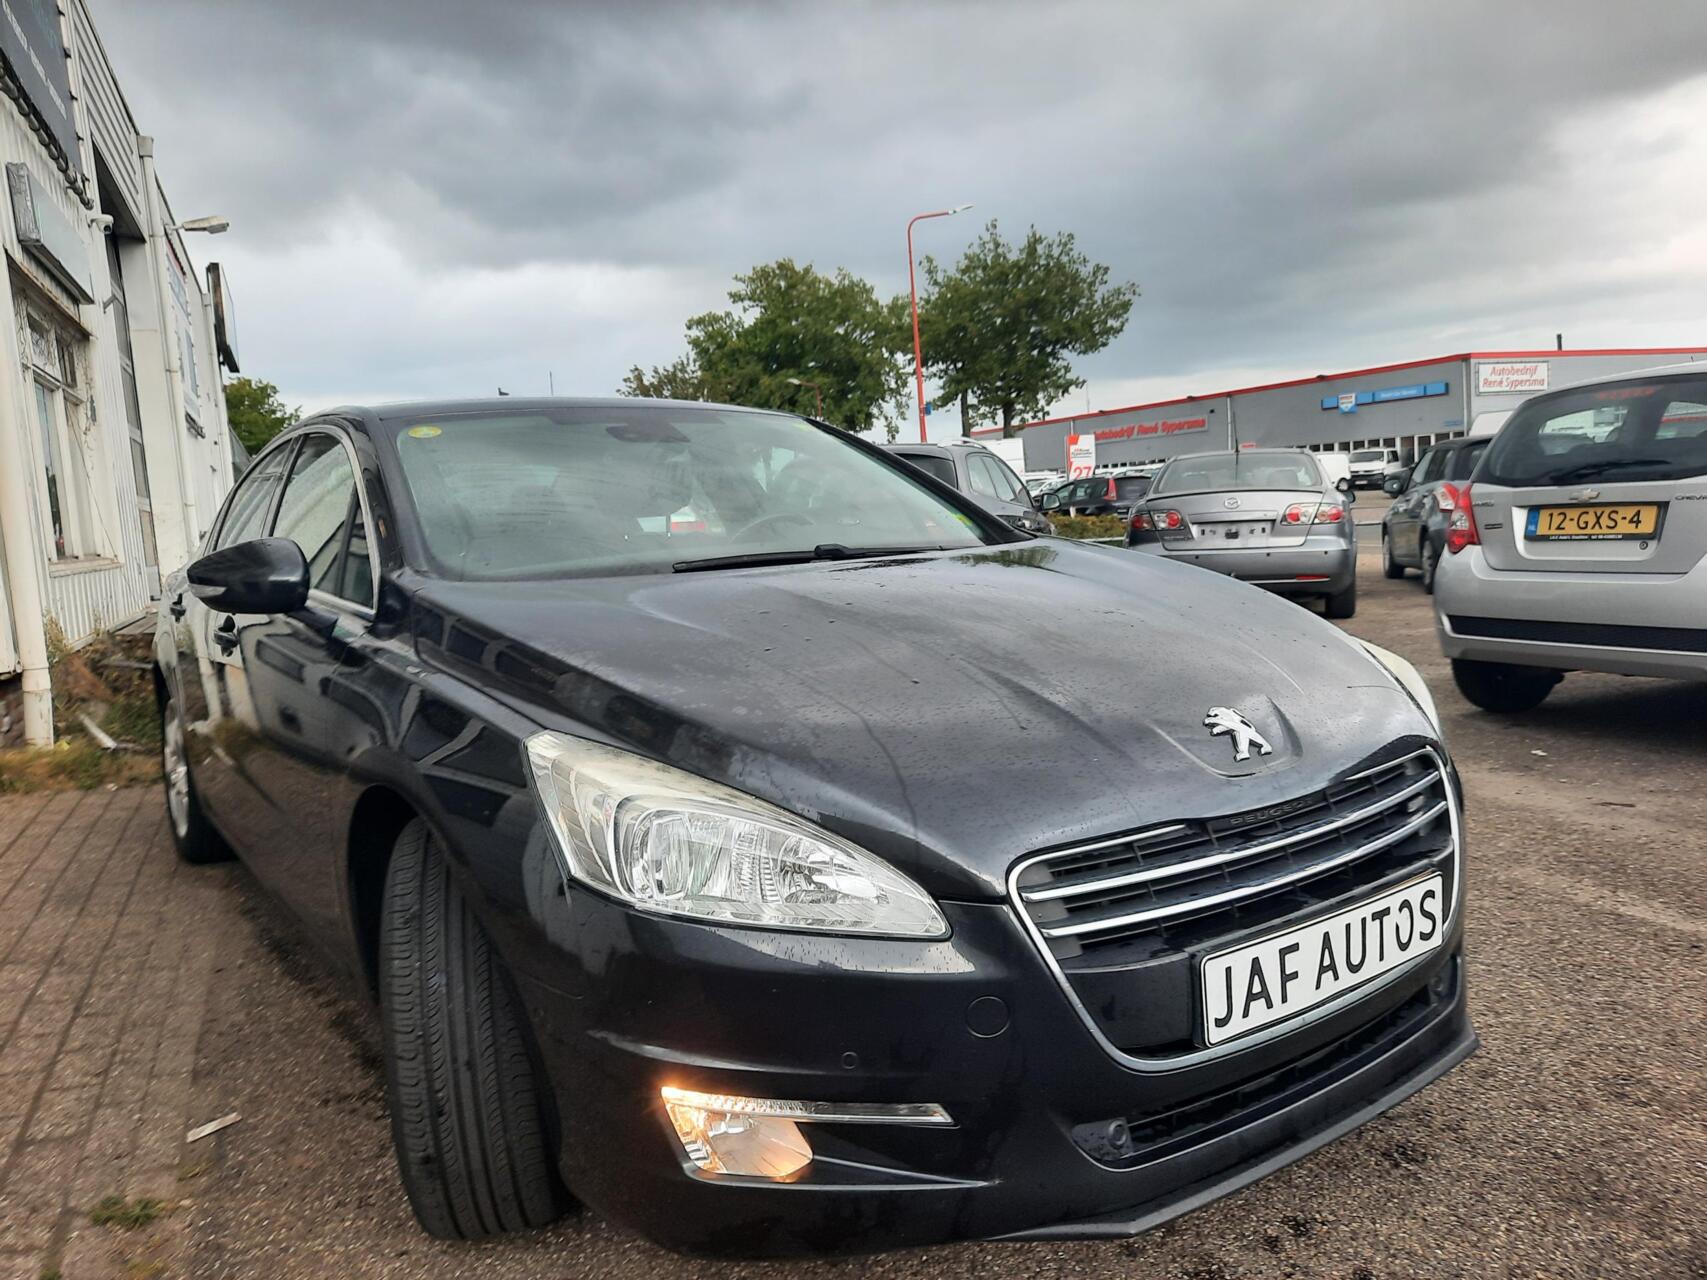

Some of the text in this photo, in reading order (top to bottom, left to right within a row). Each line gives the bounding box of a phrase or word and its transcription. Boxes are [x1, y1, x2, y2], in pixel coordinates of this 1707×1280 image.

[1490, 365, 1538, 378] Autobedrijf
[1482, 377, 1546, 390] René Sypersma
[1073, 466, 1092, 479] 27
[1548, 509, 1642, 531] 12-GXS-4
[1214, 889, 1437, 1028] JAF AUTOS
